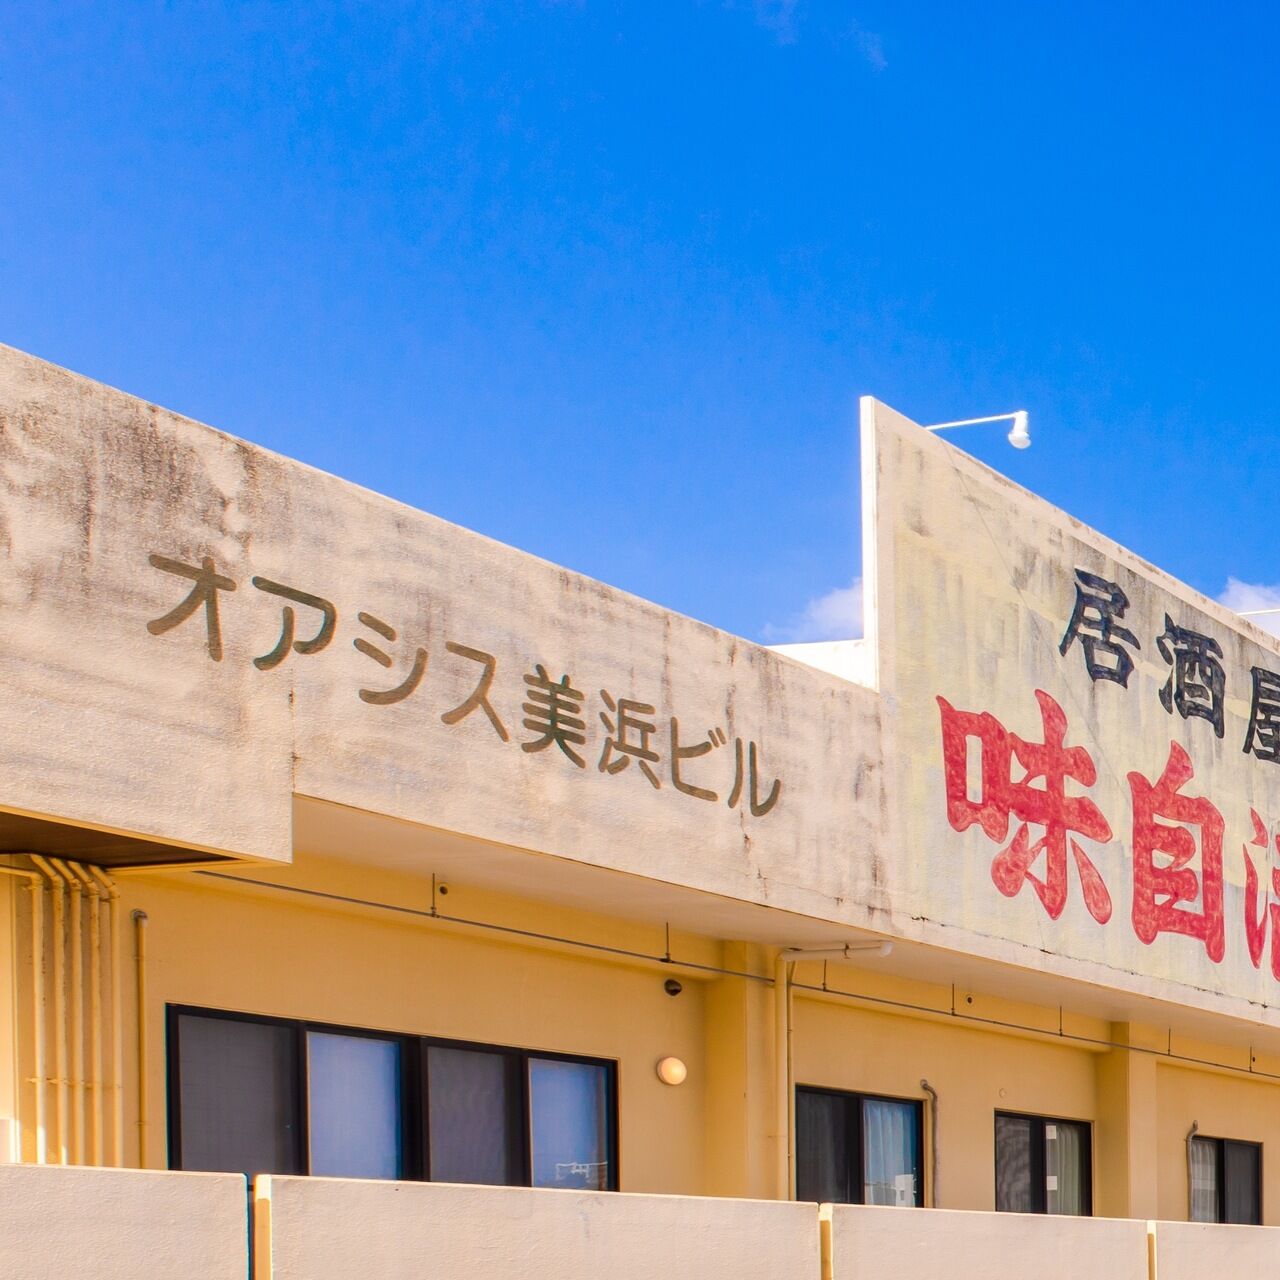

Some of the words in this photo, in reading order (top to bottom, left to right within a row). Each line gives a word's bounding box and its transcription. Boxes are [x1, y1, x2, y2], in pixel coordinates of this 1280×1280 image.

[146, 553, 782, 817] オアシス美浜ビル
